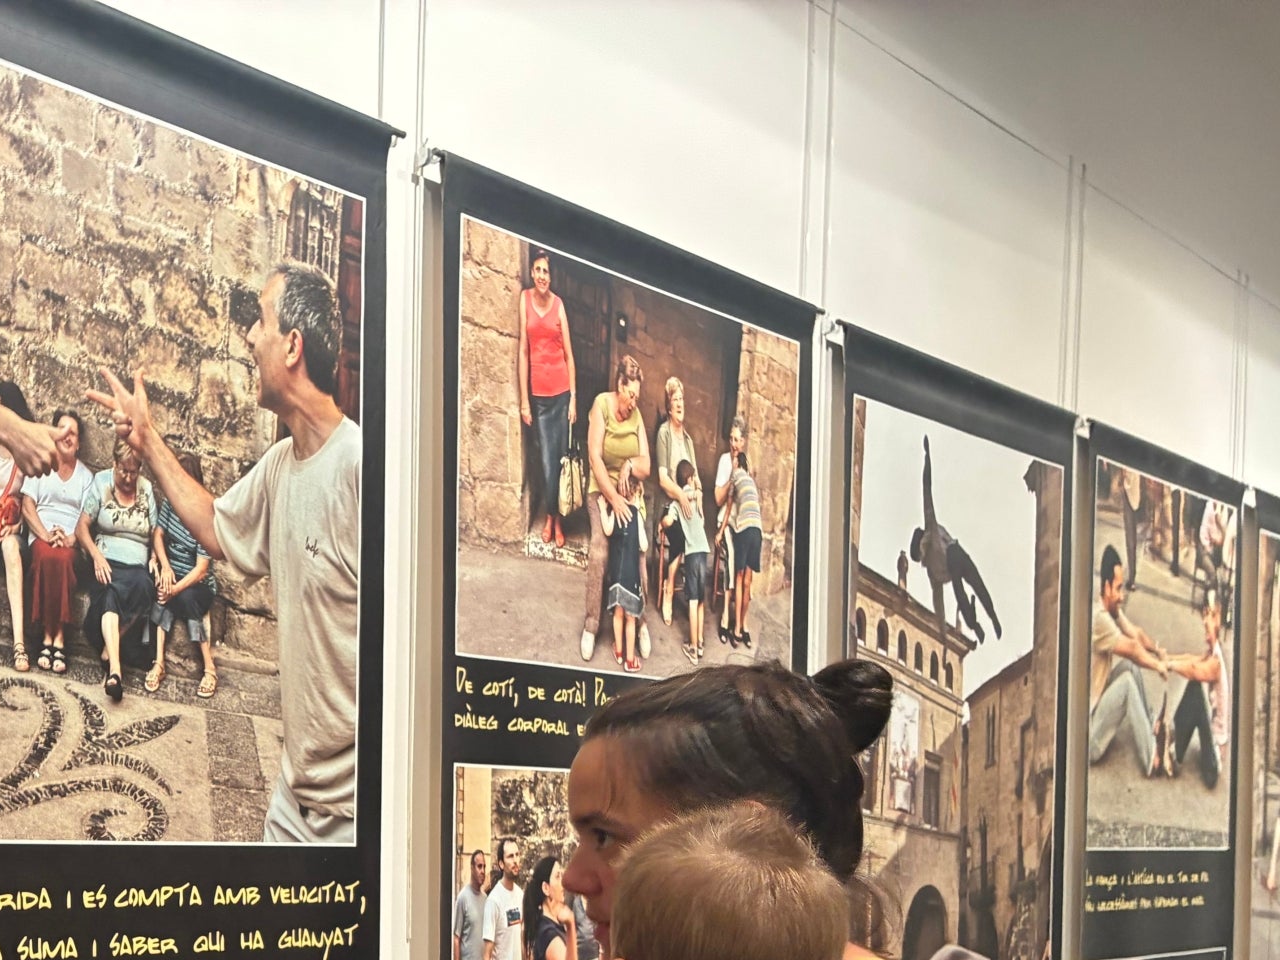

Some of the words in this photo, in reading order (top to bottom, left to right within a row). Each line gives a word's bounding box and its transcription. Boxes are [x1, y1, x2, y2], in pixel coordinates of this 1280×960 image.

[455, 665, 474, 694] DE
[527, 686, 546, 701] DE
[594, 676, 613, 707] PA
[454, 703, 499, 731] DIÀLEG
[507, 717, 570, 737] CORPORAL
[66, 890, 72, 909] I
[82, 883, 107, 909] ES
[113, 882, 203, 908] COMPTA
[213, 884, 261, 906] AMB
[269, 880, 366, 915] VELOCITAT,
[92, 939, 97, 958] I
[109, 932, 179, 957] SABER
[193, 930, 225, 953] QUI
[240, 929, 265, 950] HA
